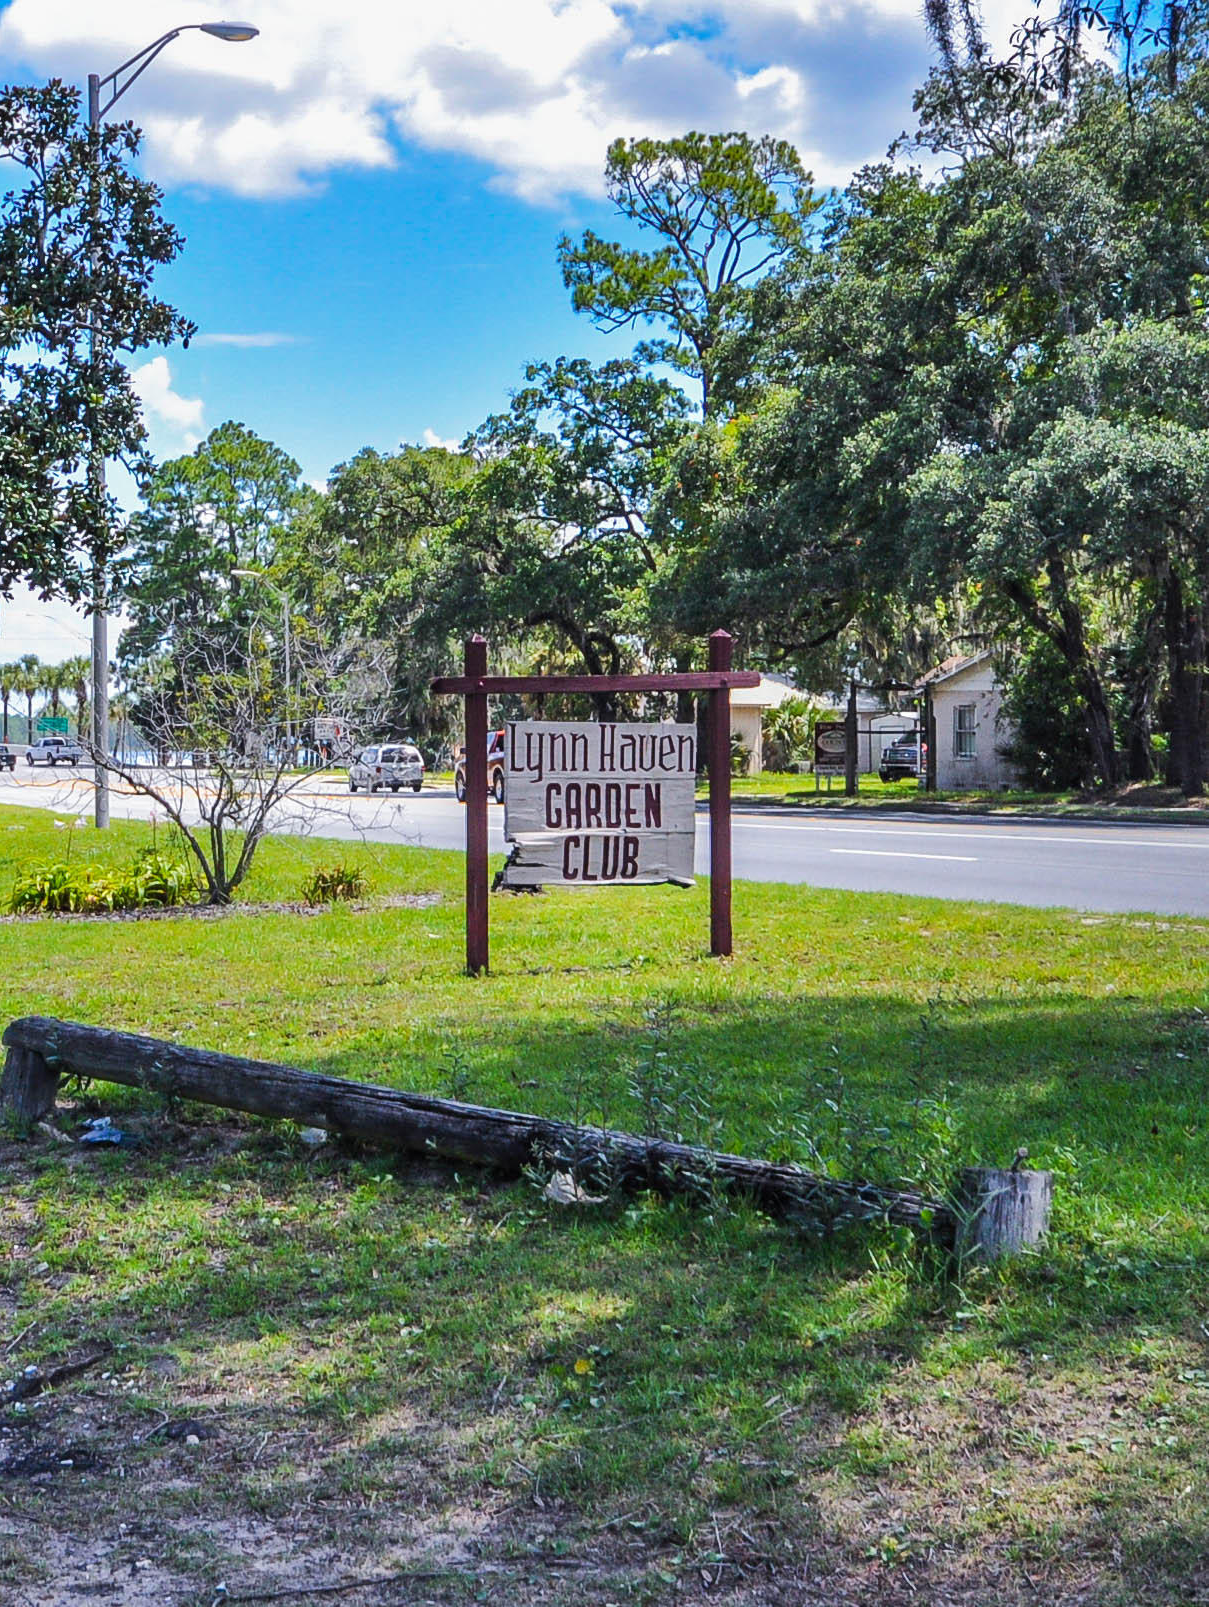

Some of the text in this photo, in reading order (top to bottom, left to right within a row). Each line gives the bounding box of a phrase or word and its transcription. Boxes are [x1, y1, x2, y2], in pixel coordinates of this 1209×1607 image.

[507, 723, 695, 783] Lynn Haven
[545, 782, 662, 829] GARDEN
[563, 835, 640, 880] CLUB
